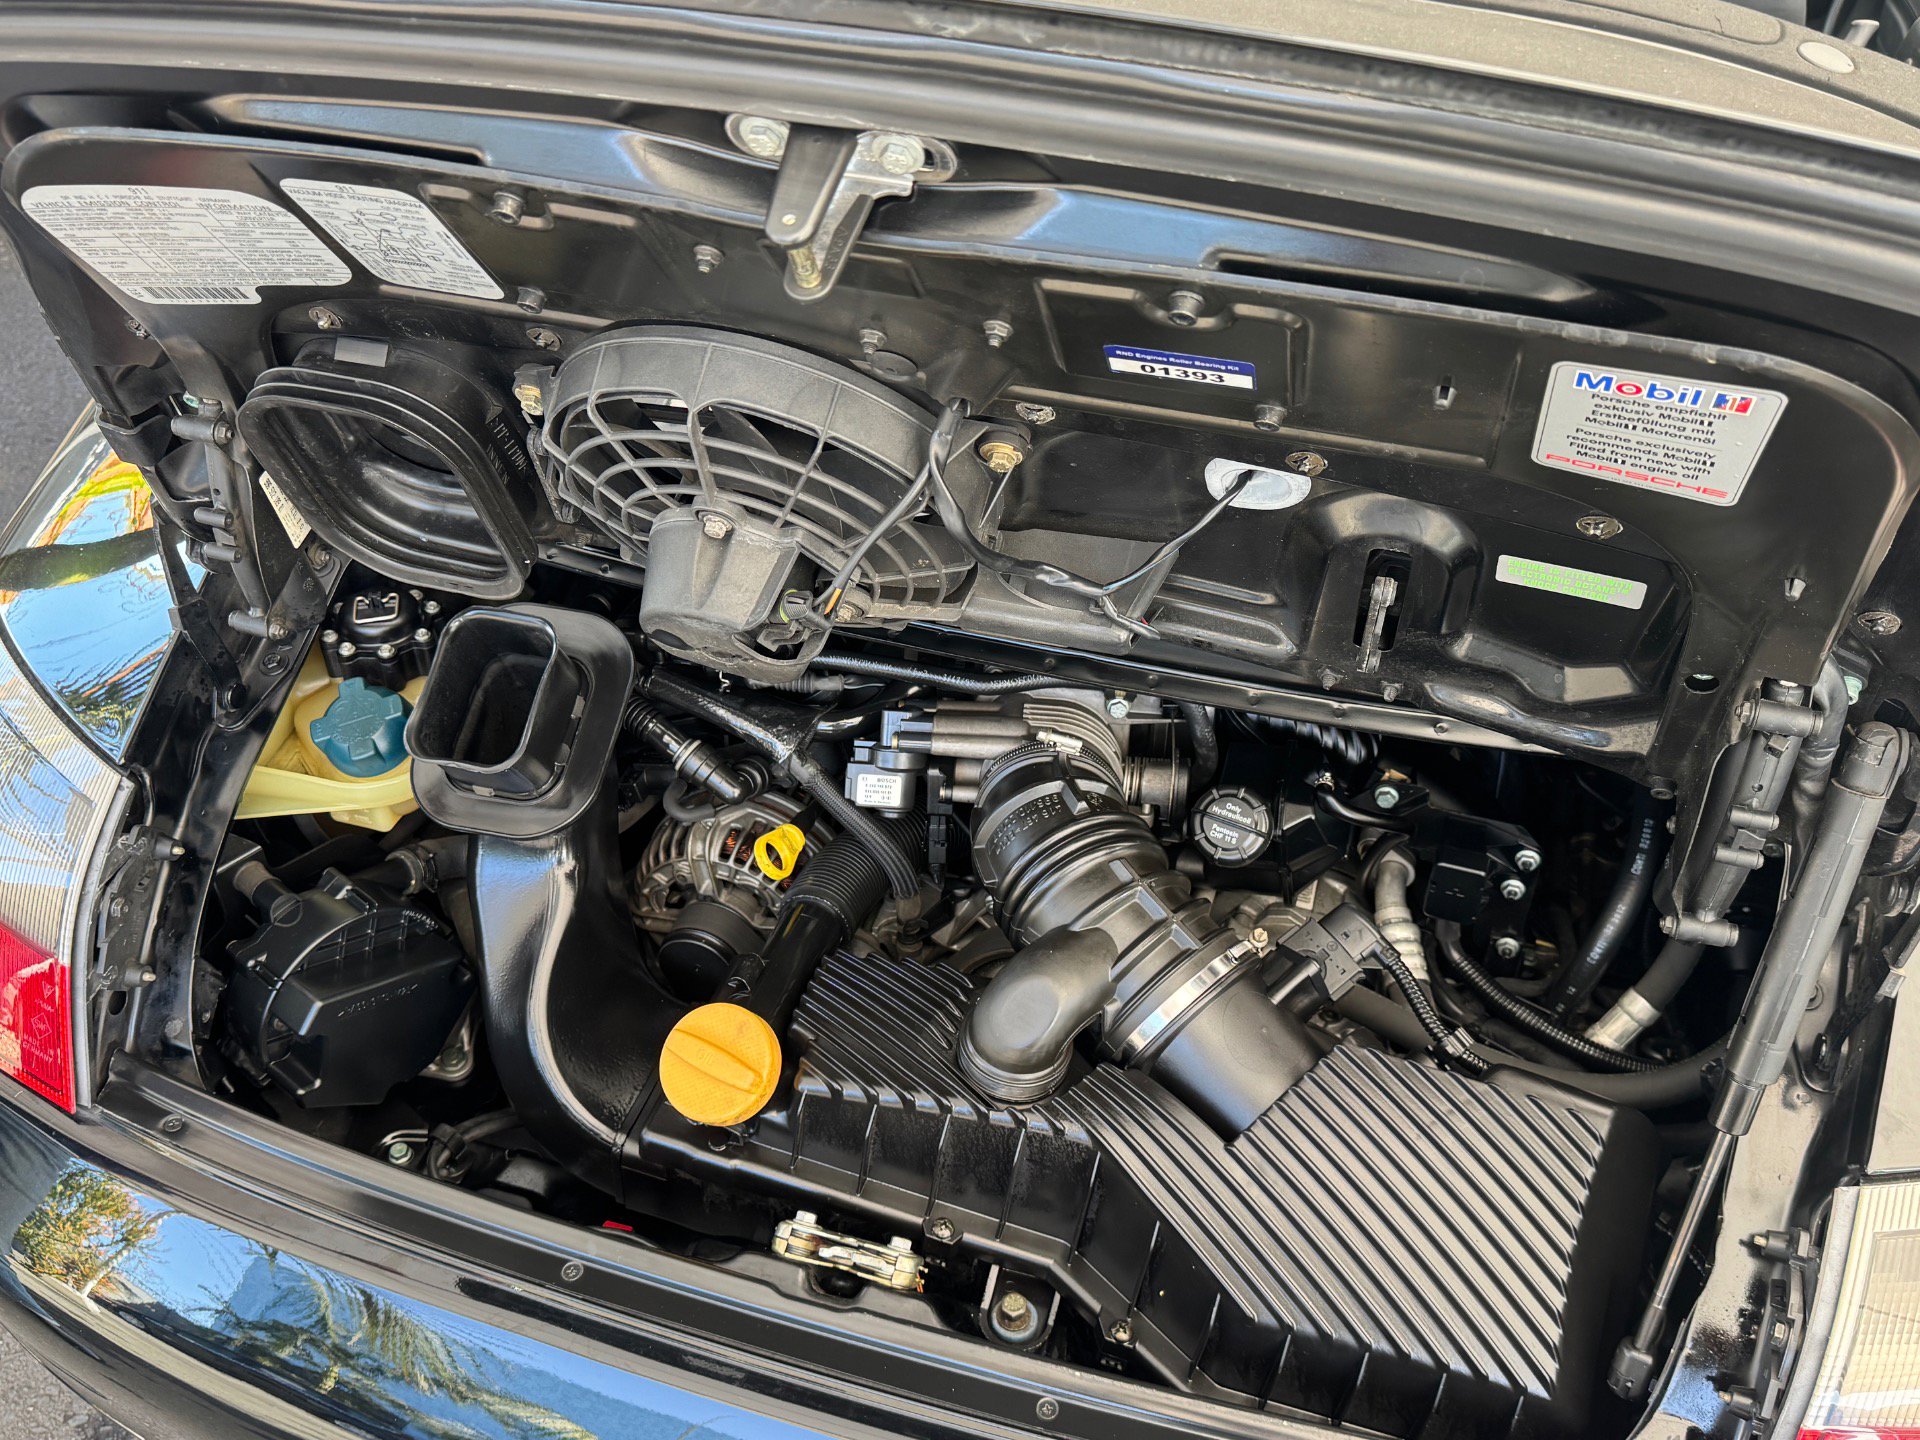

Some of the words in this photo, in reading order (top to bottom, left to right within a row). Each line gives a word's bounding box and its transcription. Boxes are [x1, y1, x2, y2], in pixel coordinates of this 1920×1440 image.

[127, 186, 149, 195] 911
[335, 185, 355, 193] 911
[196, 202, 273, 213] INFORMATION
[1116, 350, 1134, 358] RND
[1135, 352, 1168, 363] Engines
[1169, 357, 1193, 365] Roller
[1194, 360, 1226, 371] Bearing
[1140, 364, 1226, 384] 01393
[1575, 372, 1703, 406] Mobil
[1591, 393, 1650, 409] Porsche
[1655, 403, 1728, 421] empfiehlt
[1594, 402, 1655, 417] exklusiv
[1591, 409, 1686, 434] Erstbefüllung
[1691, 426, 1716, 438] mit
[1566, 434, 1659, 457] recommends
[1575, 427, 1631, 444] Porsche
[1635, 439, 1717, 461] exclusively
[1641, 426, 1716, 446] Motorenöl
[1569, 441, 1606, 454] Filled
[1610, 449, 1638, 462] from
[1646, 456, 1678, 469] new
[1681, 463, 1712, 476] with
[1545, 452, 1729, 499] PORSCHE
[1630, 459, 1677, 478] engine
[1682, 472, 1700, 481] oil
[1508, 559, 1546, 573] ENGINE
[1508, 566, 1572, 586] ELECTRONIC
[1523, 578, 1559, 592] KNOCK
[1562, 585, 1609, 602] CONTROL
[1212, 805, 1252, 825] Hydraulicoil
[1226, 802, 1242, 814] Only
[1209, 830, 1224, 840] CHF
[1211, 823, 1239, 838] Pentosin
[22, 1041, 54, 1064] GERMANY
